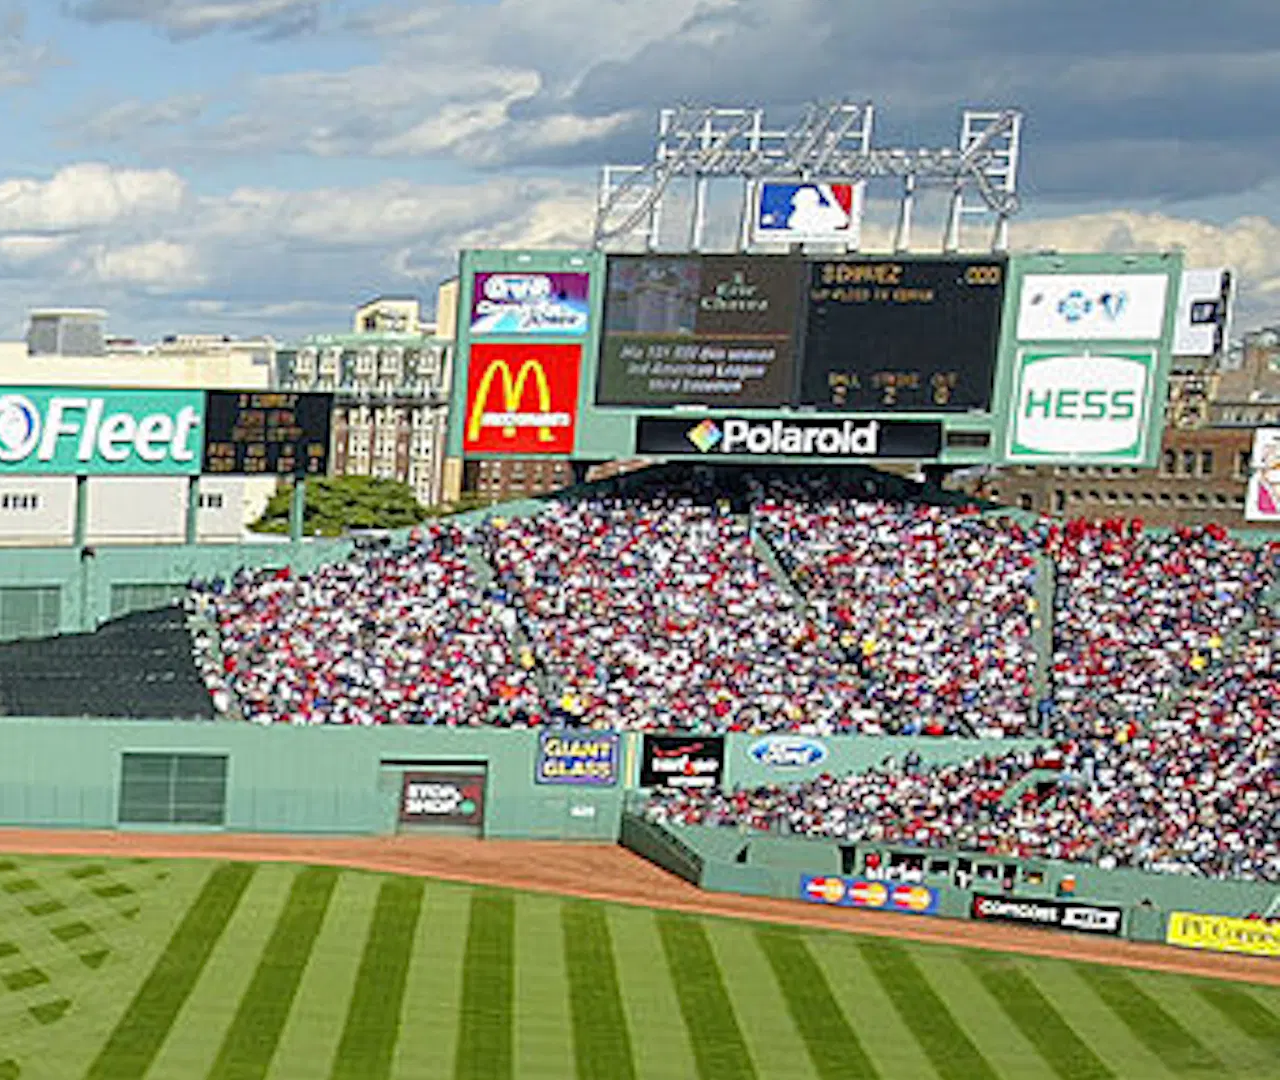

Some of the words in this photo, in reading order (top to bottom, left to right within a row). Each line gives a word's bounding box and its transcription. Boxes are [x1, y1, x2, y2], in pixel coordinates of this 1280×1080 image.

[1025, 389, 1136, 419] HESS
[37, 397, 201, 463] Fleet
[723, 420, 880, 454] Polaroid
[544, 737, 612, 758] GIANT
[762, 743, 811, 768] Ford
[543, 760, 612, 778] GLASS
